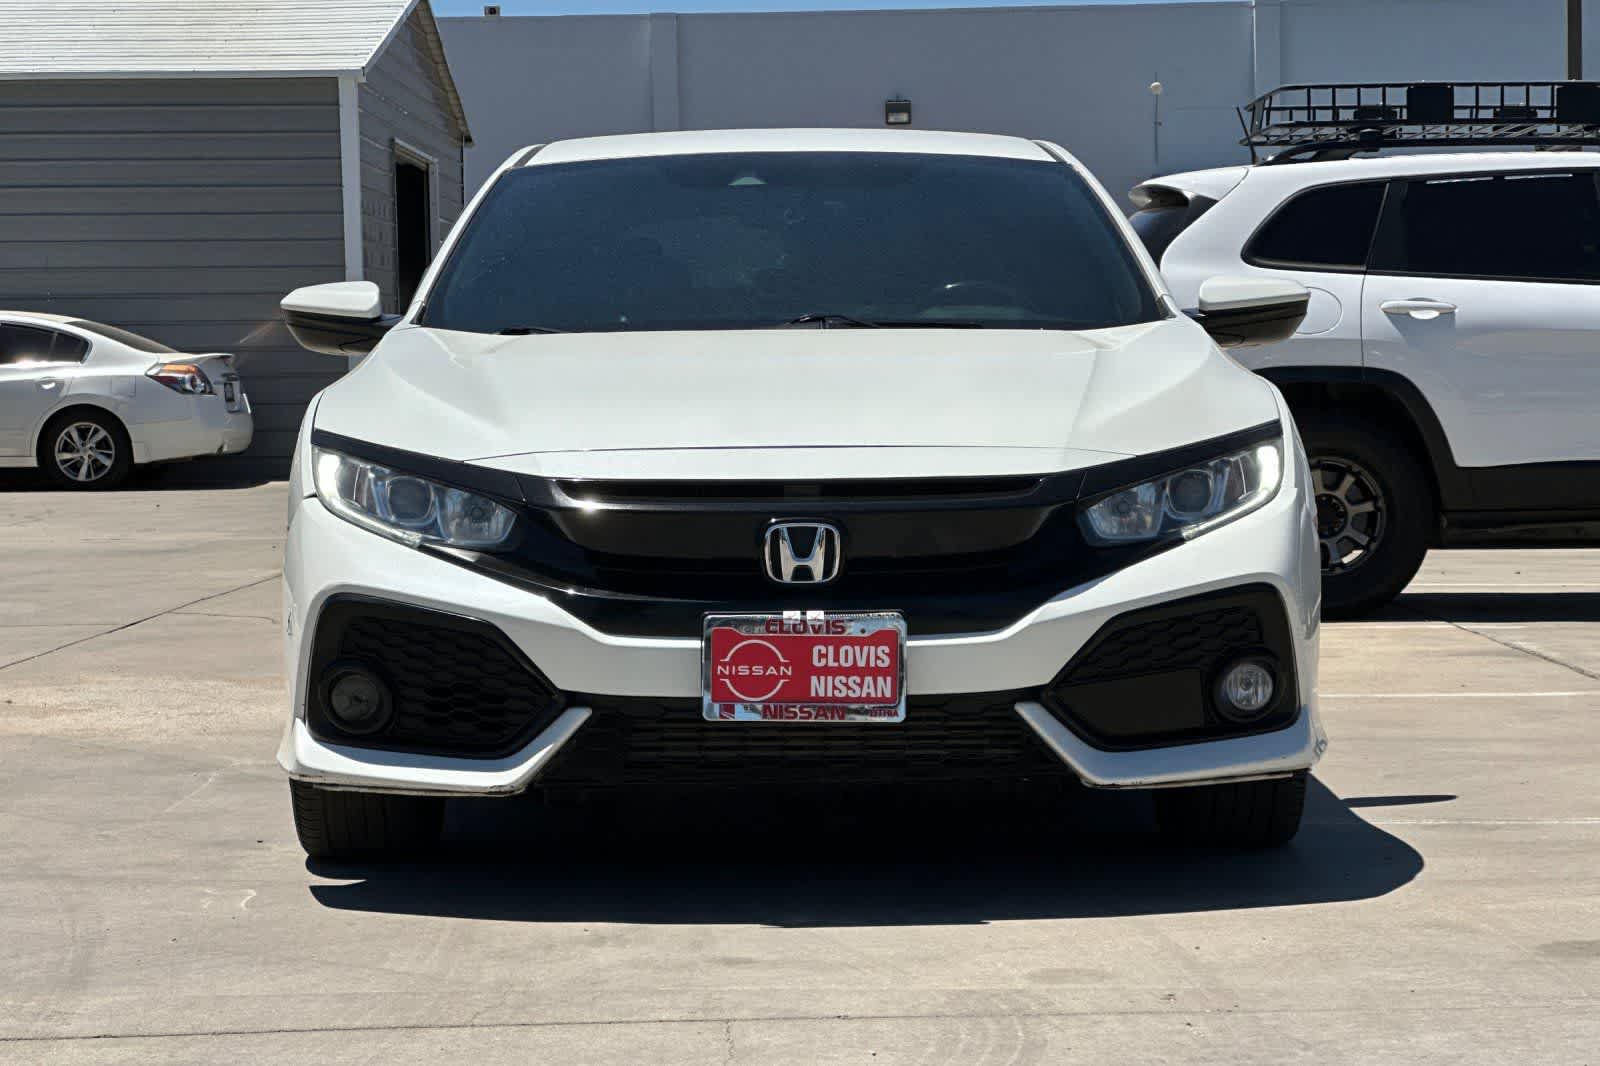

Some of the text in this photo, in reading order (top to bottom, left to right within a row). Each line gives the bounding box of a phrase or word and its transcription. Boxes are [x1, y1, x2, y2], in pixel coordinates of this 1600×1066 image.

[765, 618, 846, 635] CLOVIS
[813, 645, 890, 668] CLOVIS
[716, 665, 792, 676] NISSAN
[810, 676, 892, 698] NISSAN
[762, 705, 846, 721] NISSAN
